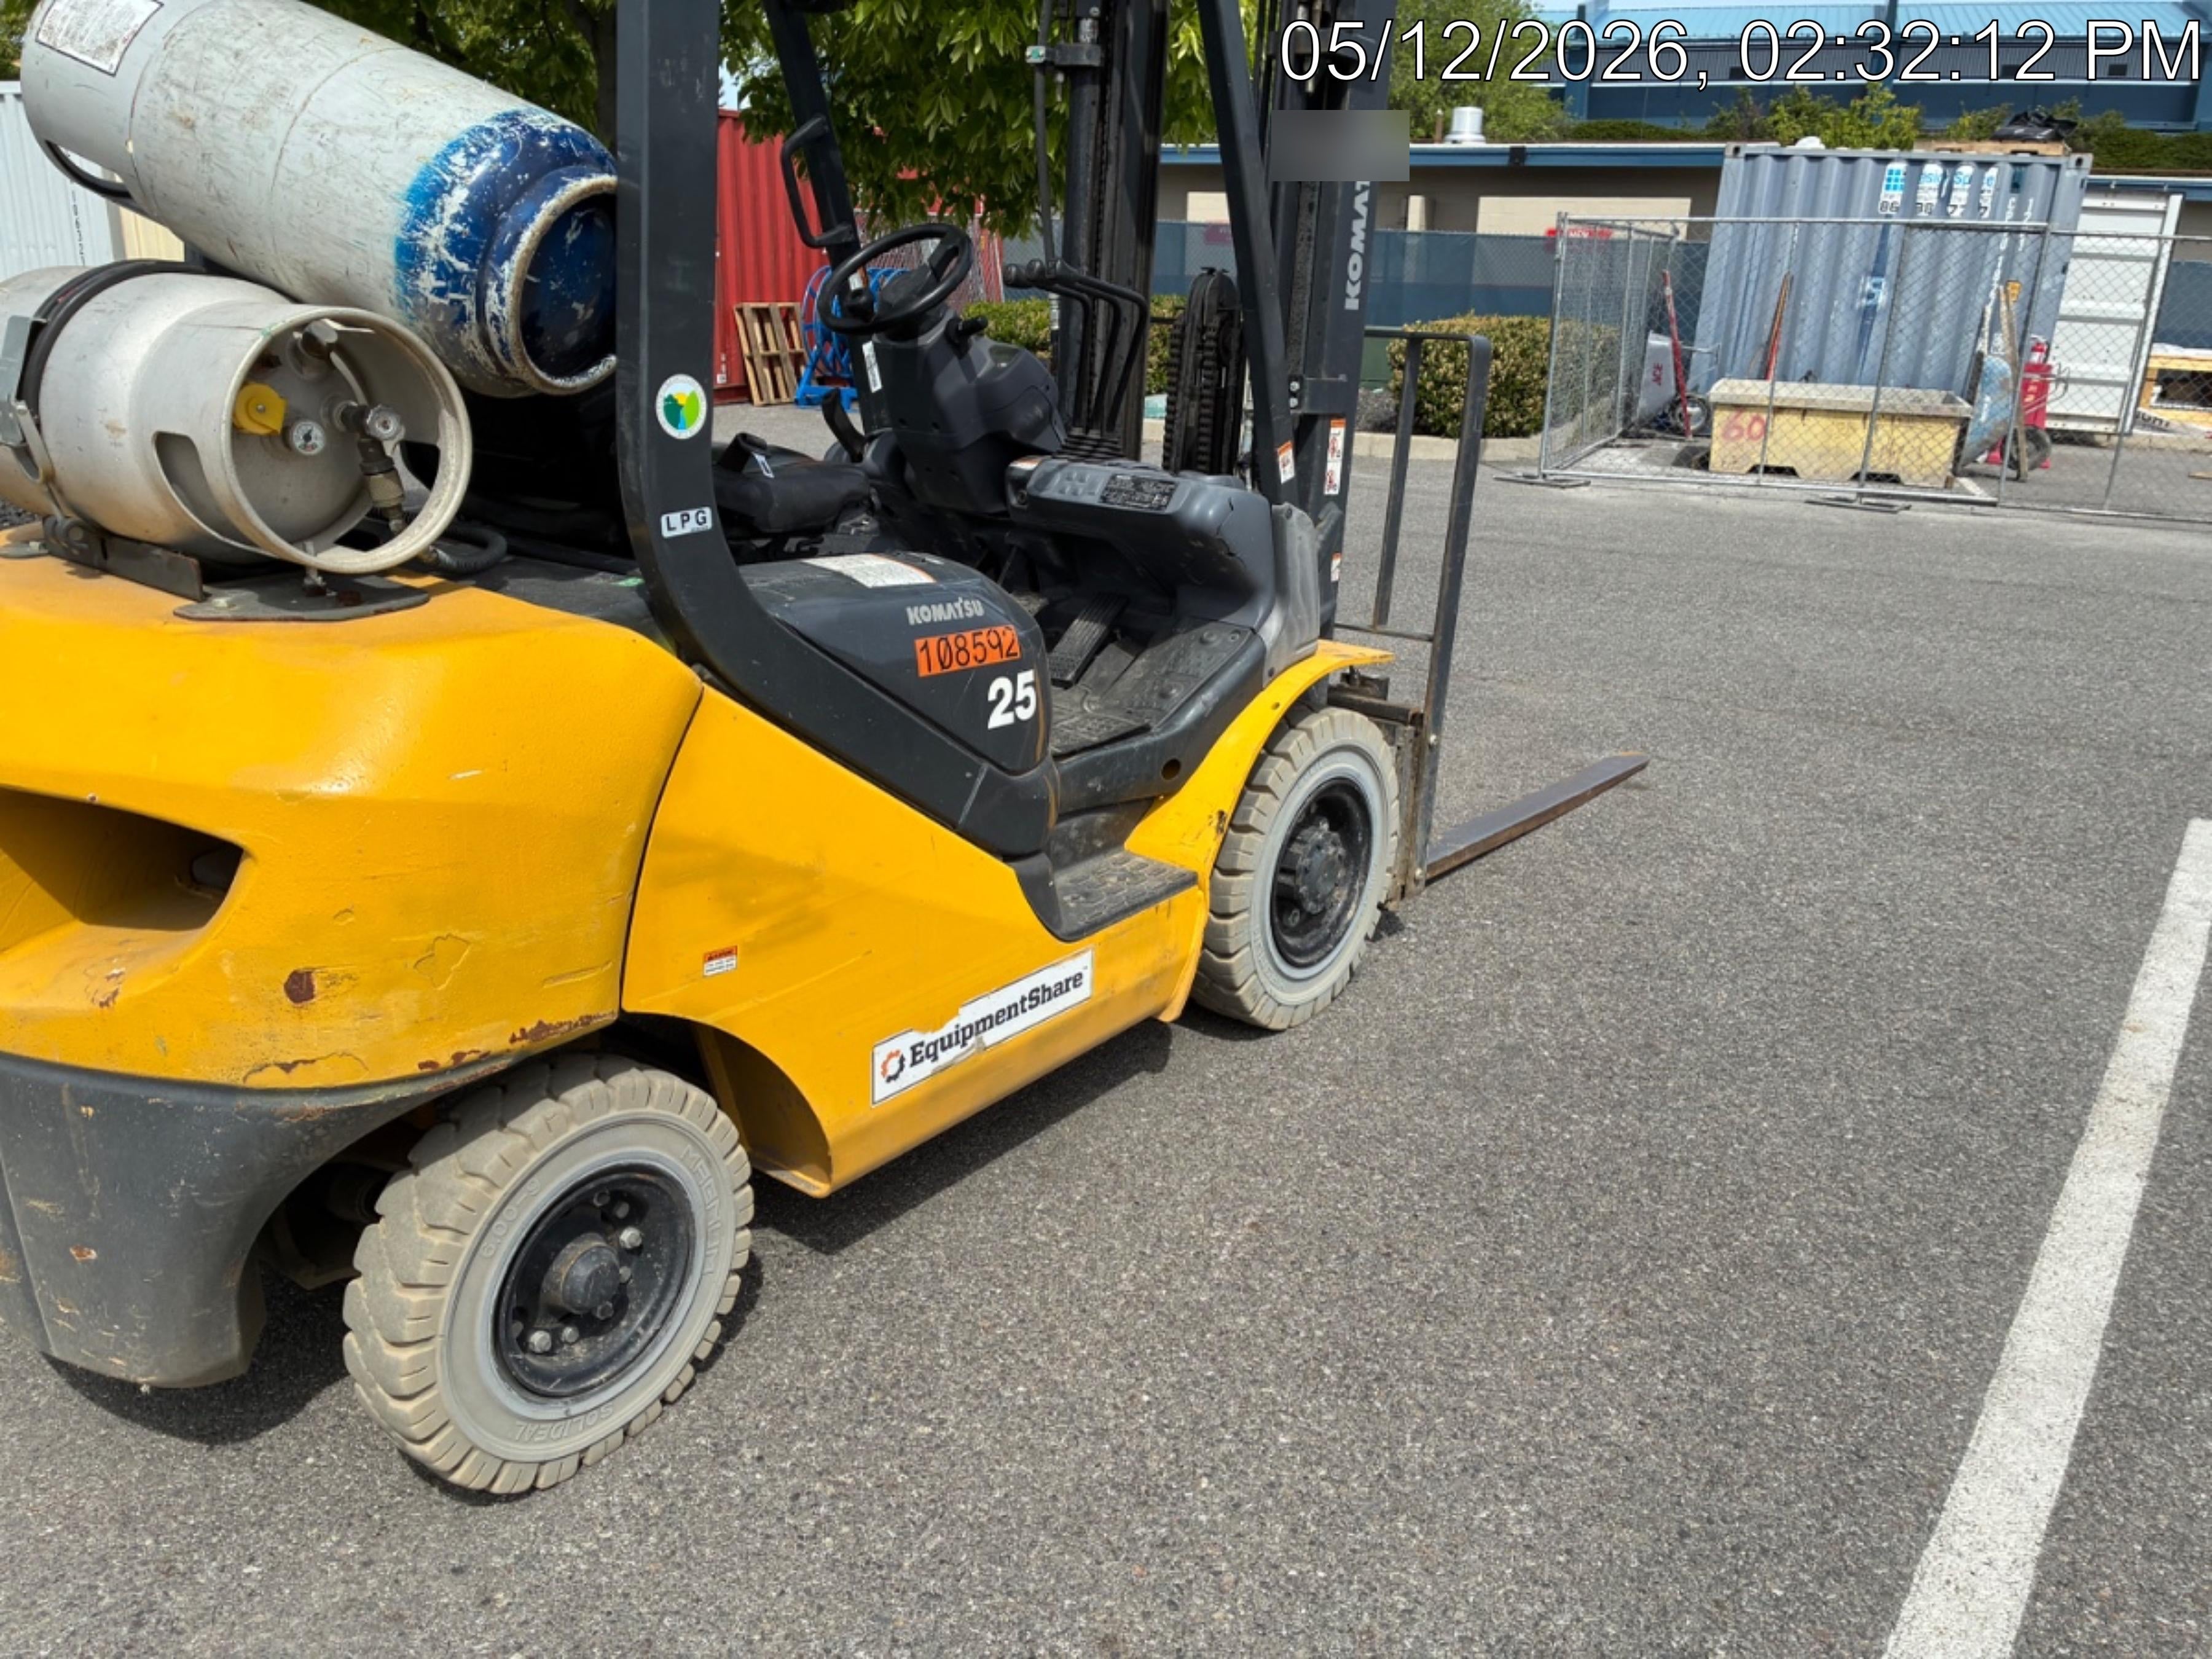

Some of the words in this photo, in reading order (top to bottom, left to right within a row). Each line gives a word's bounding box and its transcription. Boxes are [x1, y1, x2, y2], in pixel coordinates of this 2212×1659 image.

[1722, 408, 1765, 441] 60
[906, 597, 984, 625] KOMATSU
[919, 626, 1018, 673] 108592
[987, 669, 1037, 729] 25
[909, 971, 1083, 1068] EquipmentShare
[480, 1177, 541, 1257] 6.00-9
[514, 1404, 617, 1442] SOLIDEAL
